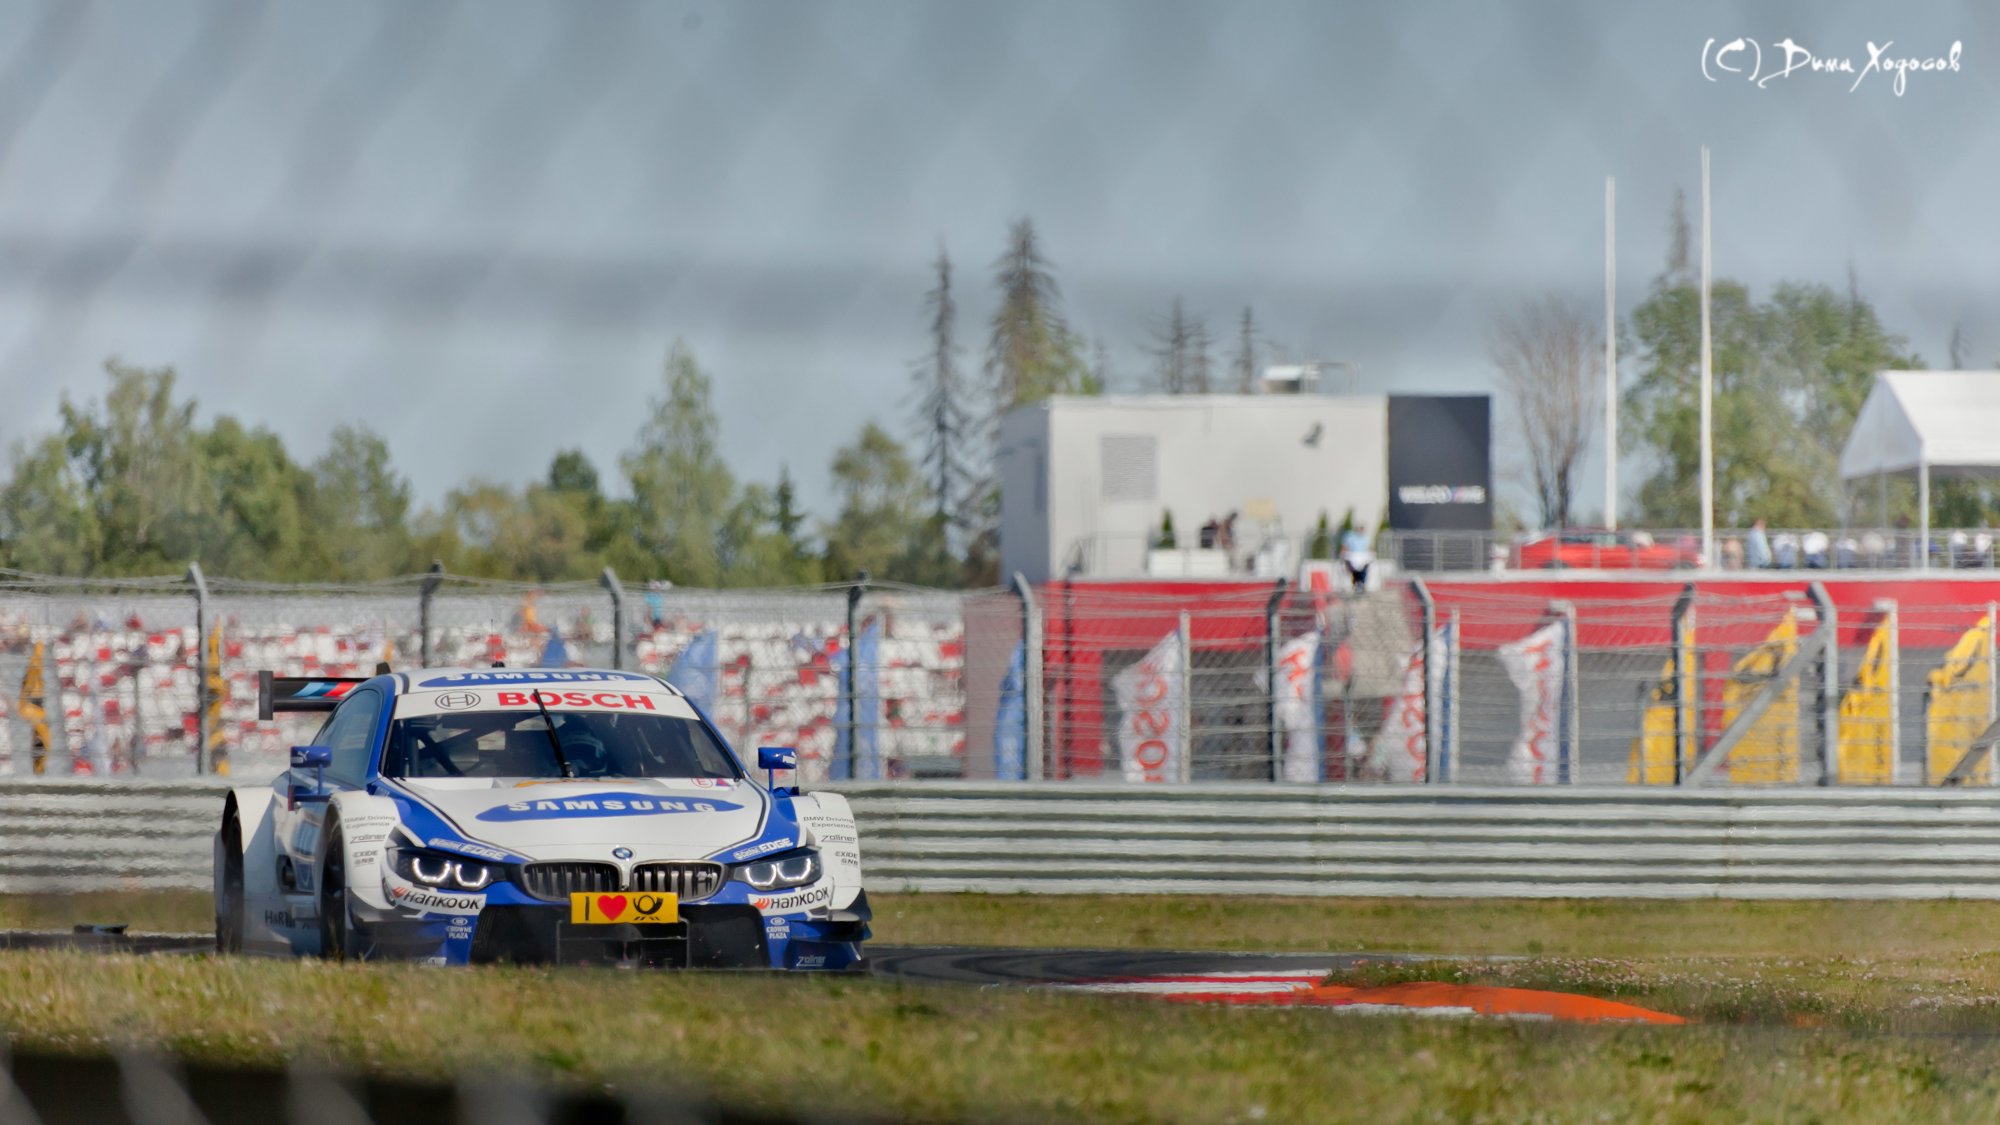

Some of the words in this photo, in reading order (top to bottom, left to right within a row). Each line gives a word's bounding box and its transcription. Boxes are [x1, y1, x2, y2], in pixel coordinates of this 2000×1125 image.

[447, 673, 627, 682] SAMSUNG
[497, 691, 656, 710] BOSCH
[507, 800, 716, 812] SAMSUNG
[758, 837, 794, 852] EDGE
